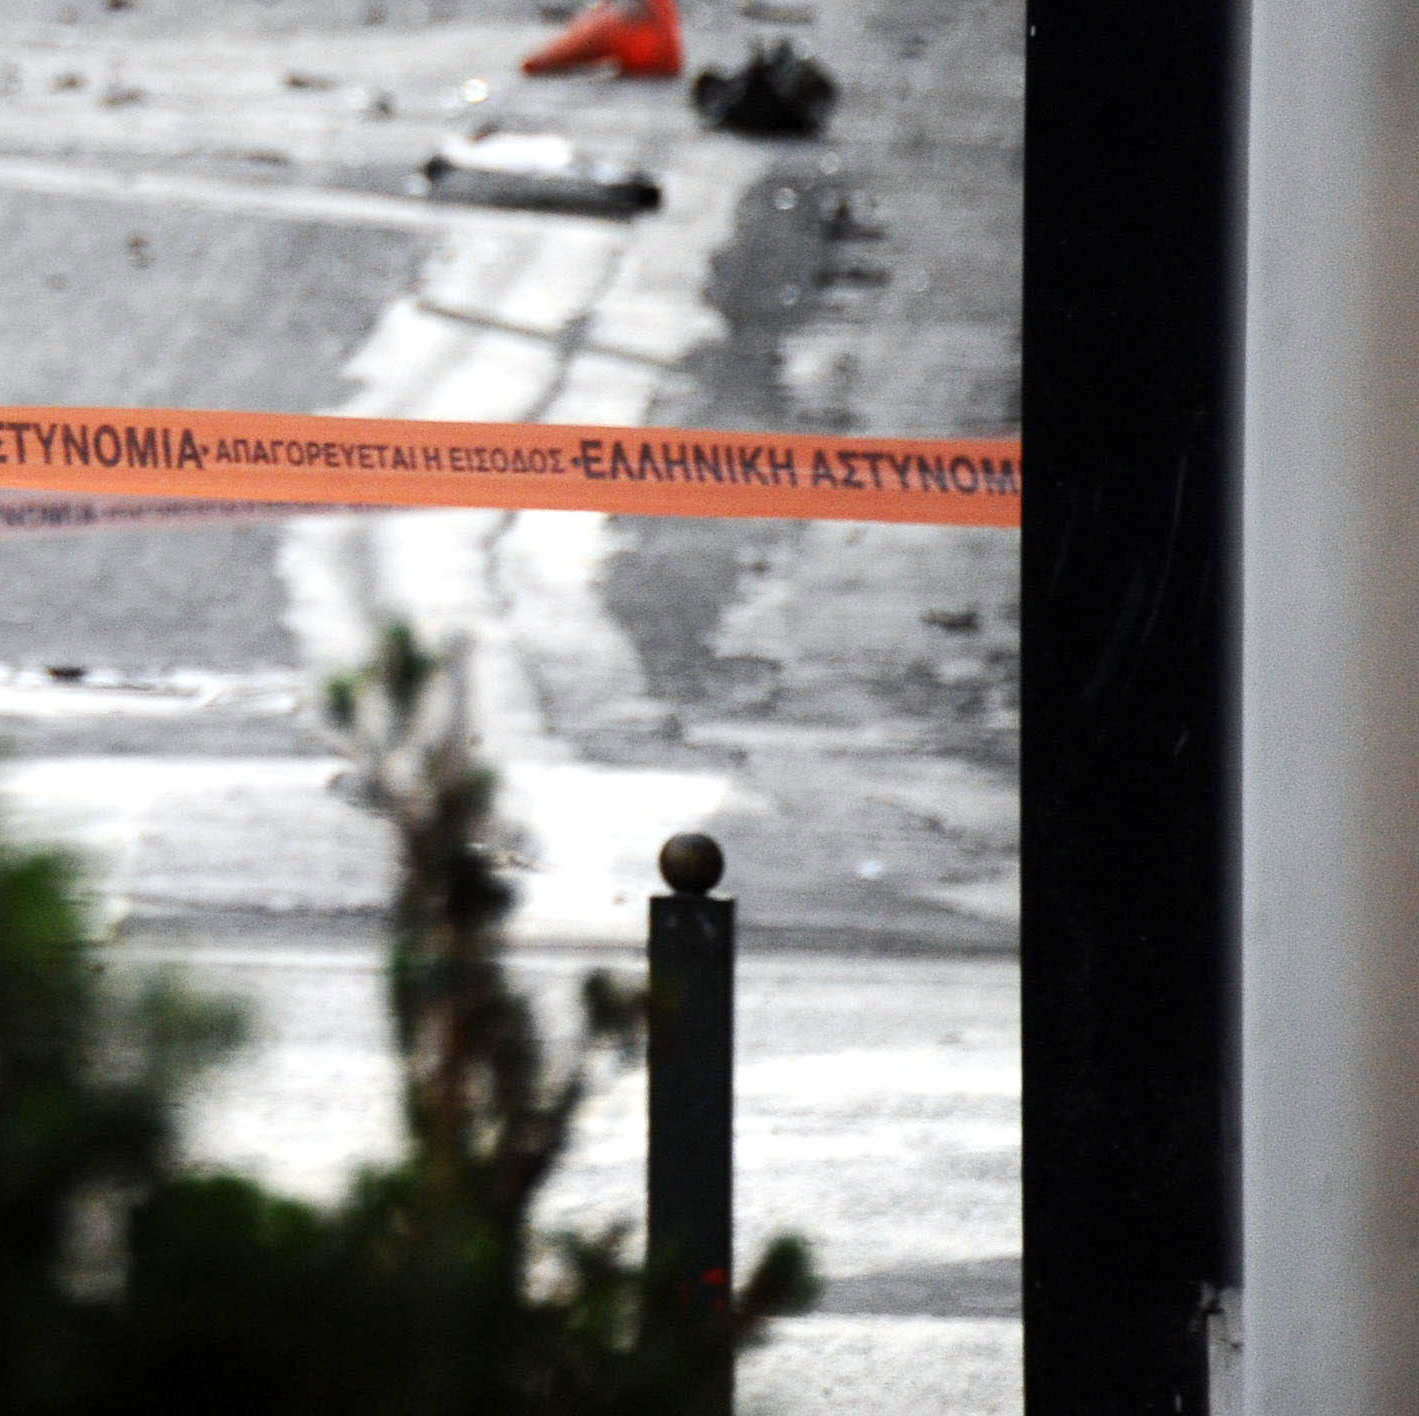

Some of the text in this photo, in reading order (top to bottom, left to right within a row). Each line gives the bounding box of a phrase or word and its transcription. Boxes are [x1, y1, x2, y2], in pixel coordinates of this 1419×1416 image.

[450, 446, 565, 473] ΕΙΣΟΔΟΣ
[580, 440, 798, 488] ΕΛΛΗΝΙΚΗ
[811, 448, 1022, 495] ΑΣΤΥΝΟΜ
